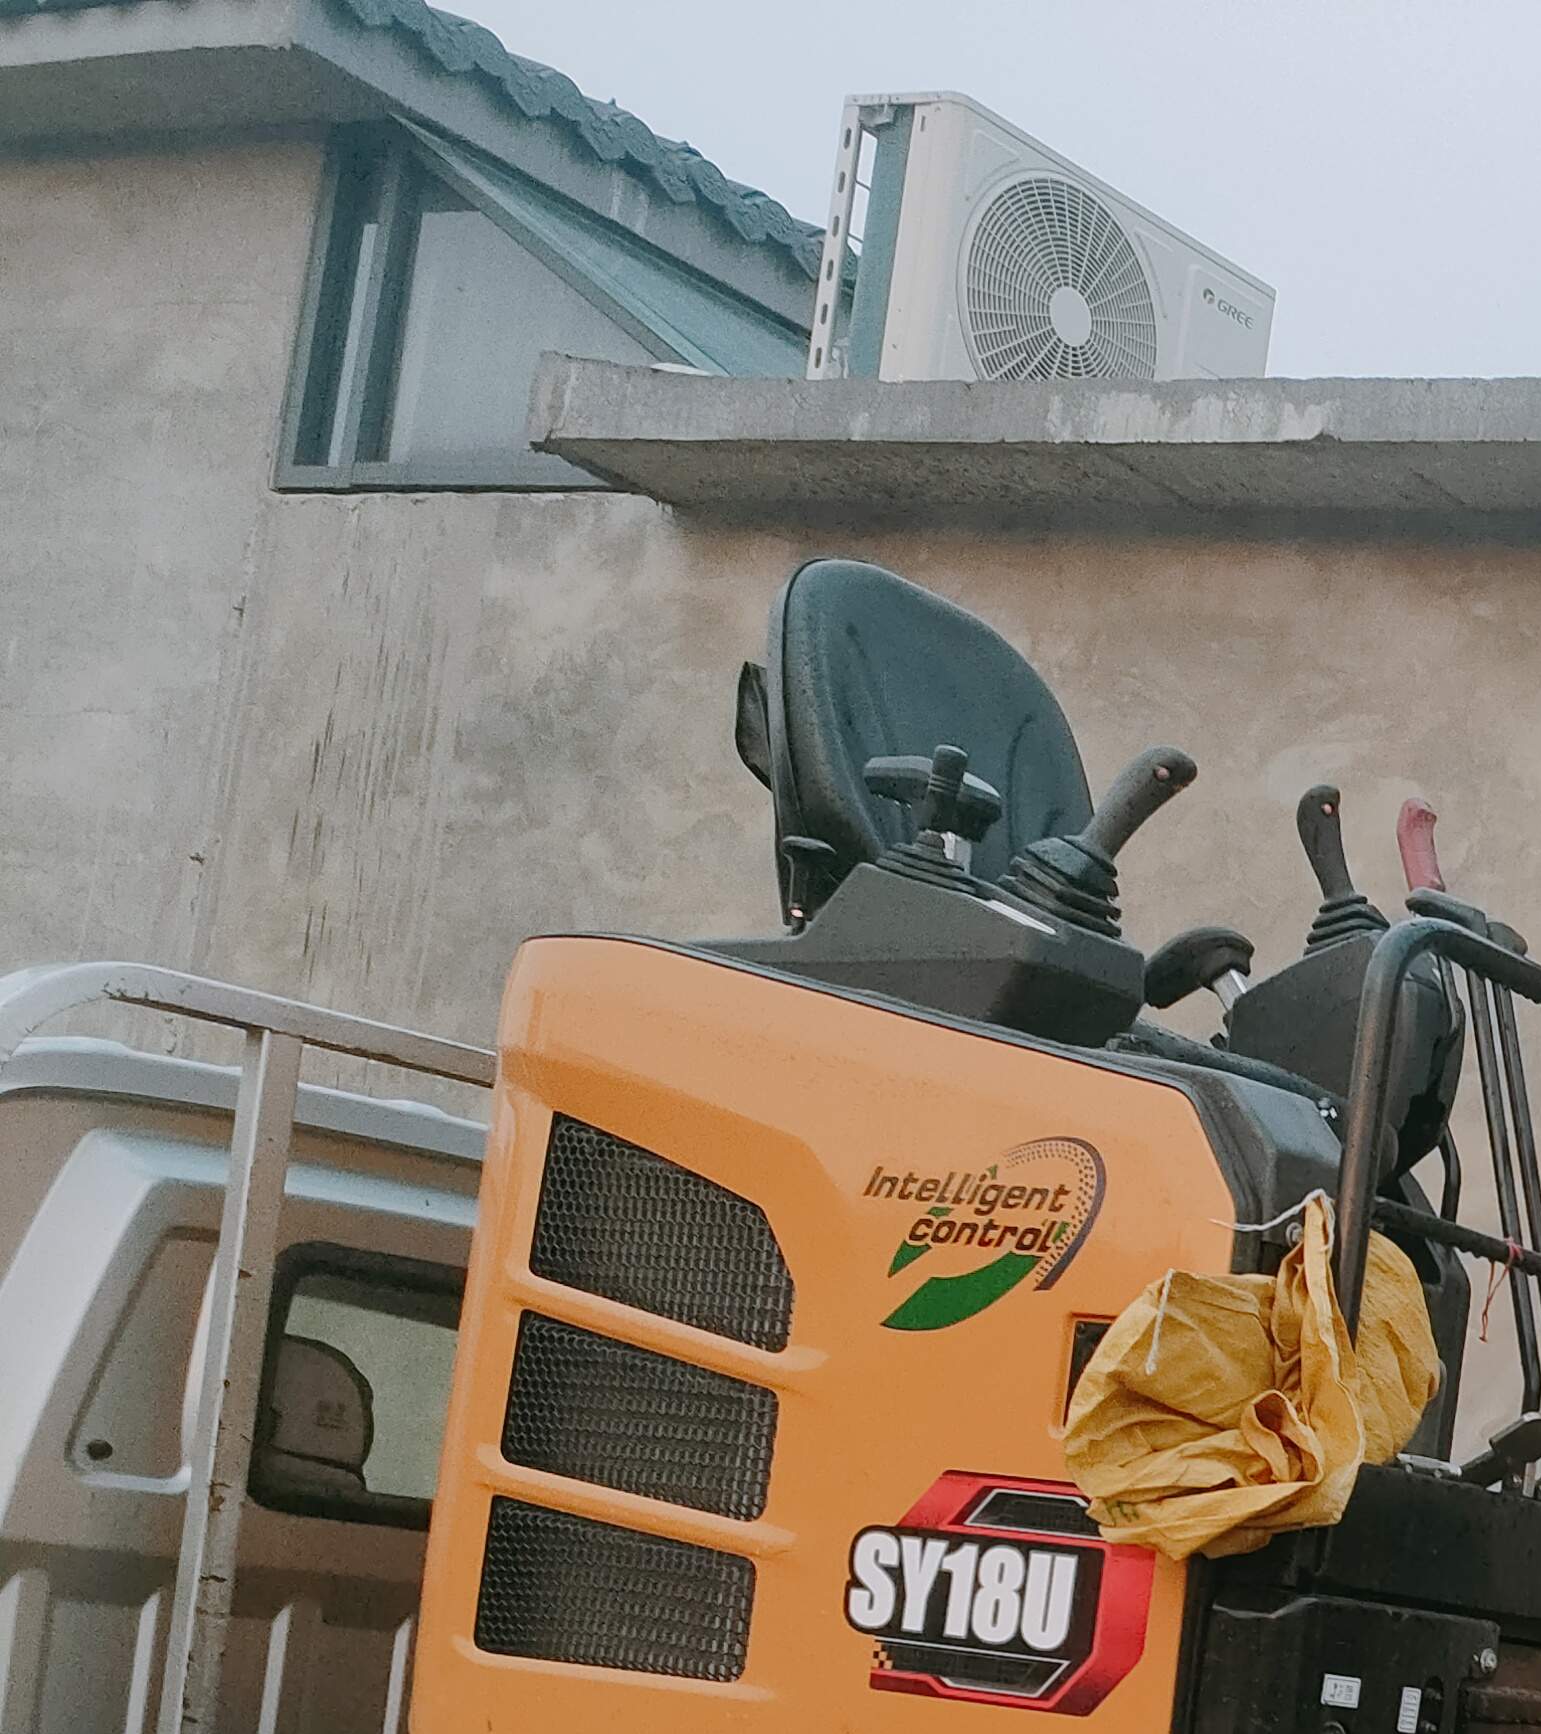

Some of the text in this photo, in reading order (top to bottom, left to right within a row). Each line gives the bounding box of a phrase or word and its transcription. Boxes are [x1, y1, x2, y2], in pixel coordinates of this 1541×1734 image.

[1217, 298, 1255, 330] GREE
[863, 1166, 1072, 1217] Intelligent
[908, 1217, 1058, 1253] control
[848, 1530, 1079, 1651] SY18U
